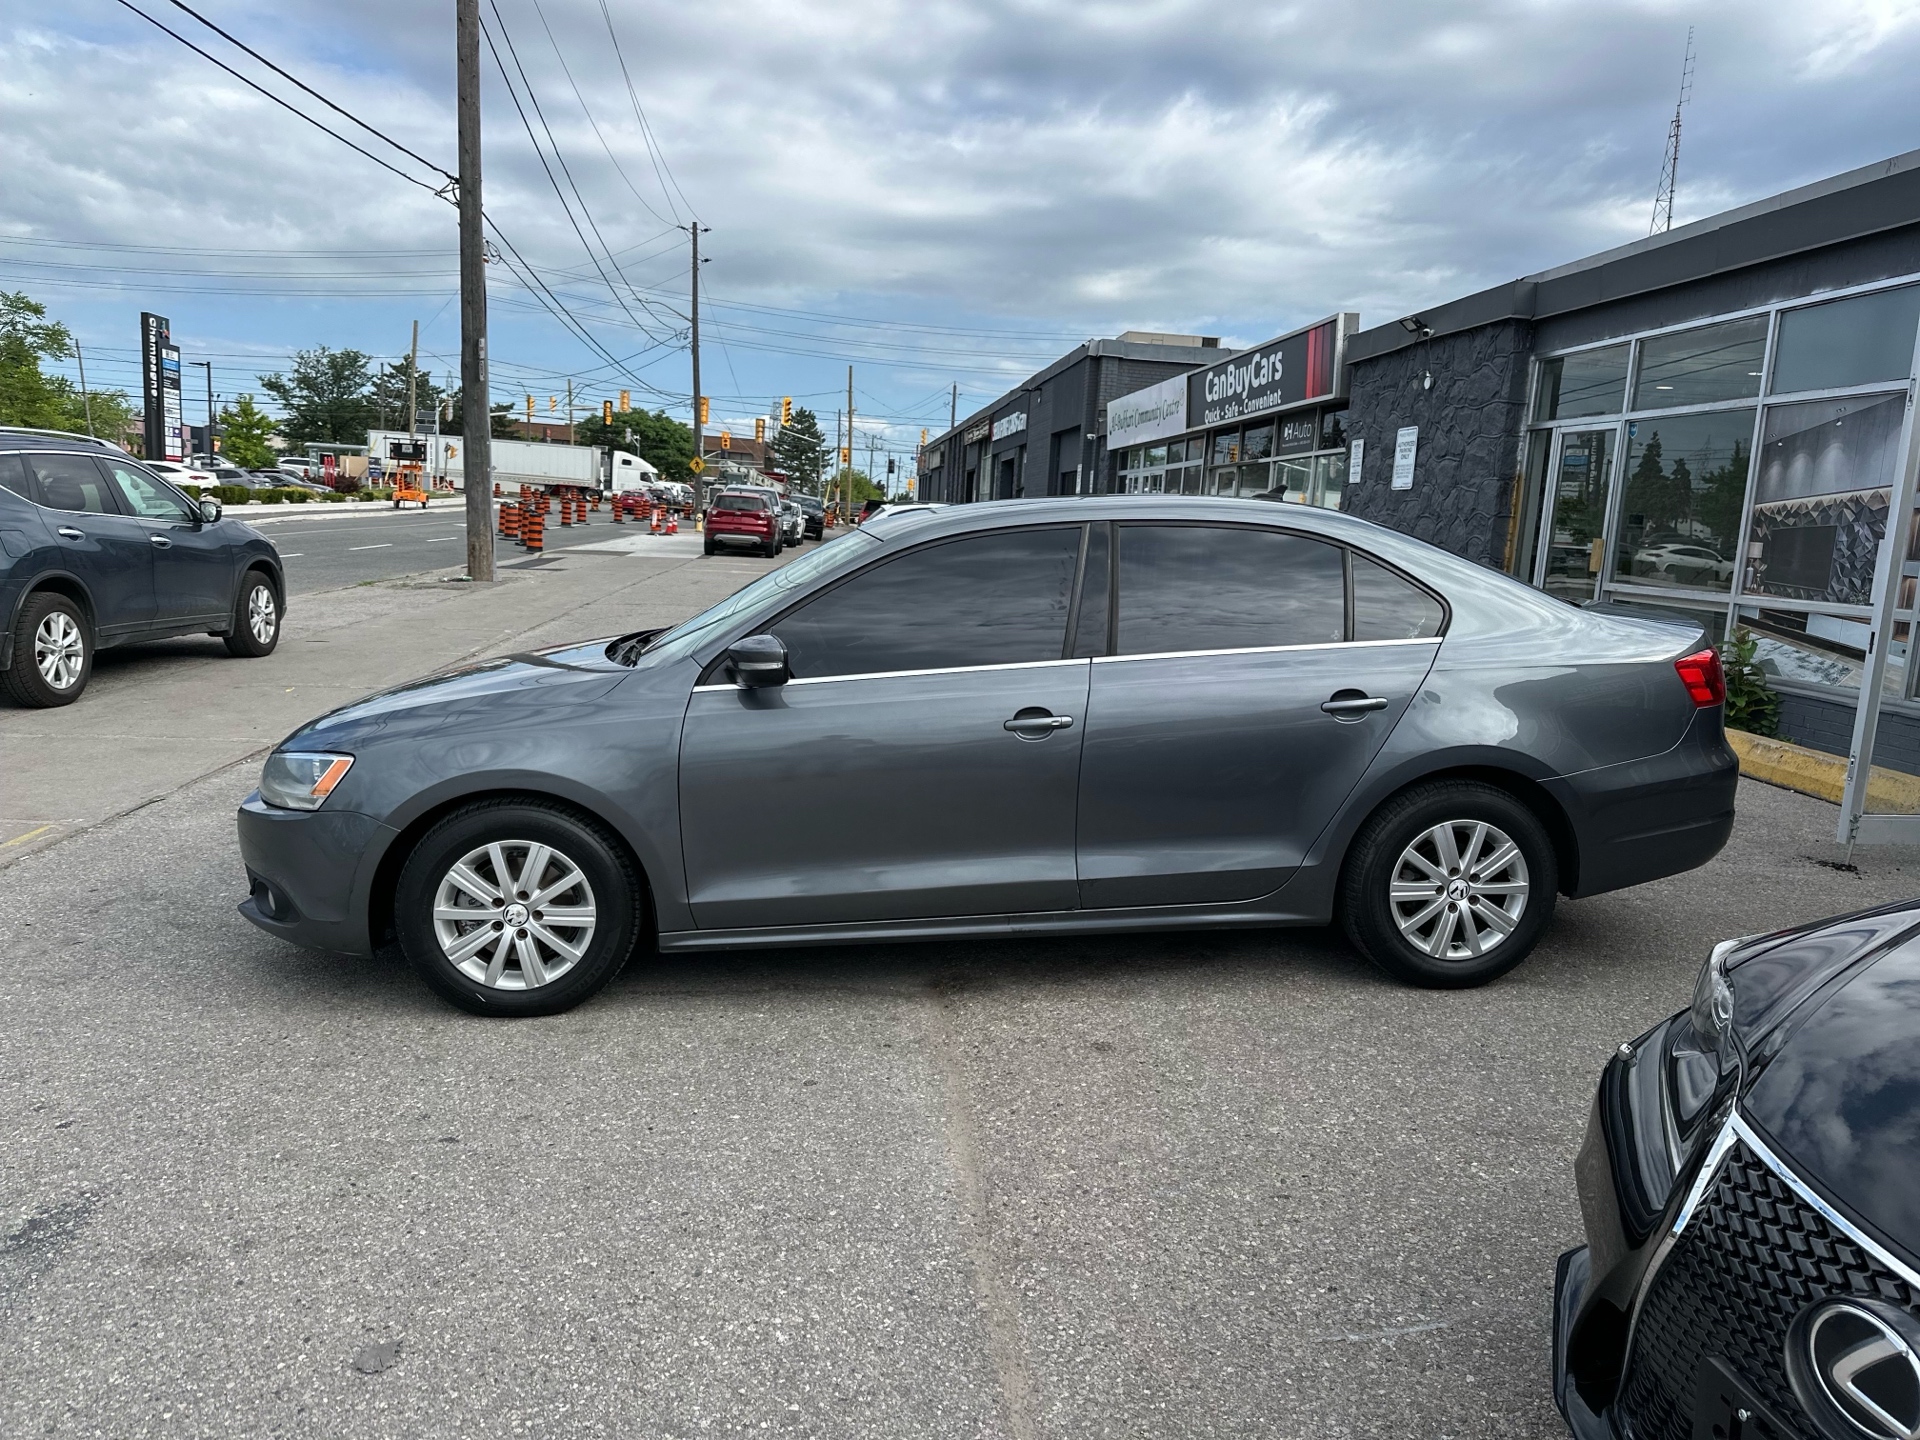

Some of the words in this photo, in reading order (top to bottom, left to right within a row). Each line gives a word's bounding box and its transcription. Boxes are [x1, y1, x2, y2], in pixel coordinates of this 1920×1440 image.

[1205, 351, 1283, 403] CanBuyCars
[1134, 401, 1162, 428] Community
[1162, 399, 1181, 421] Centre
[1204, 406, 1220, 425] Quick
[1225, 401, 1239, 419] Safe
[1243, 388, 1282, 413] Convenient
[1293, 421, 1312, 439] Auto
